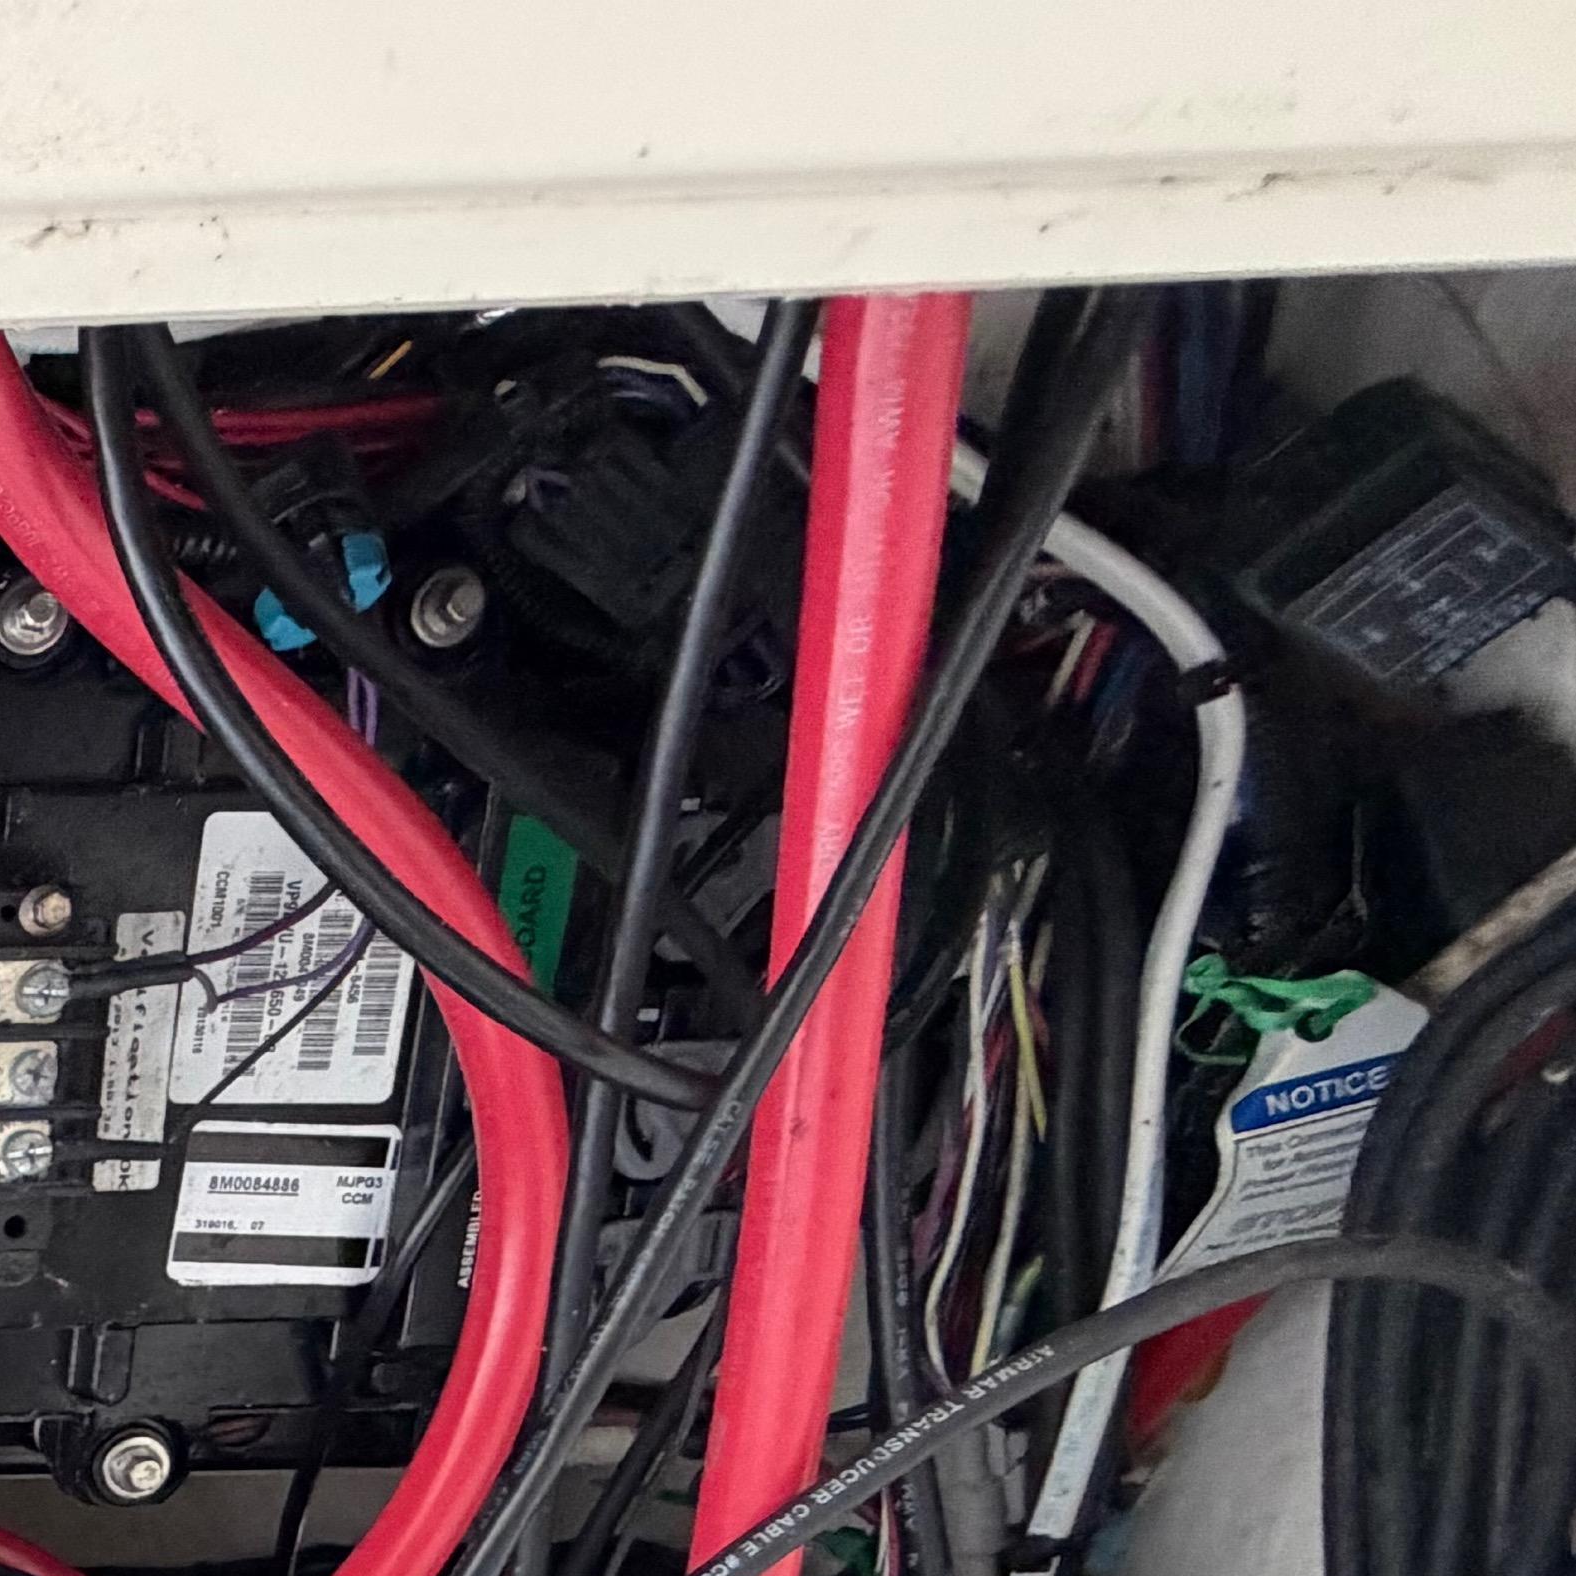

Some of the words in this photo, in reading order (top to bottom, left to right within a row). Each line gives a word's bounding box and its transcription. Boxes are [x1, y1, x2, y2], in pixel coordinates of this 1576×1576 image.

[516, 863, 547, 963] OARD
[1263, 1064, 1391, 1118] NOTICE
[341, 1192, 373, 1204] CCM
[960, 1340, 1056, 1405] AIRMAR
[809, 1394, 963, 1508] TRANSDUCER
[736, 1499, 812, 1561] CABLE
